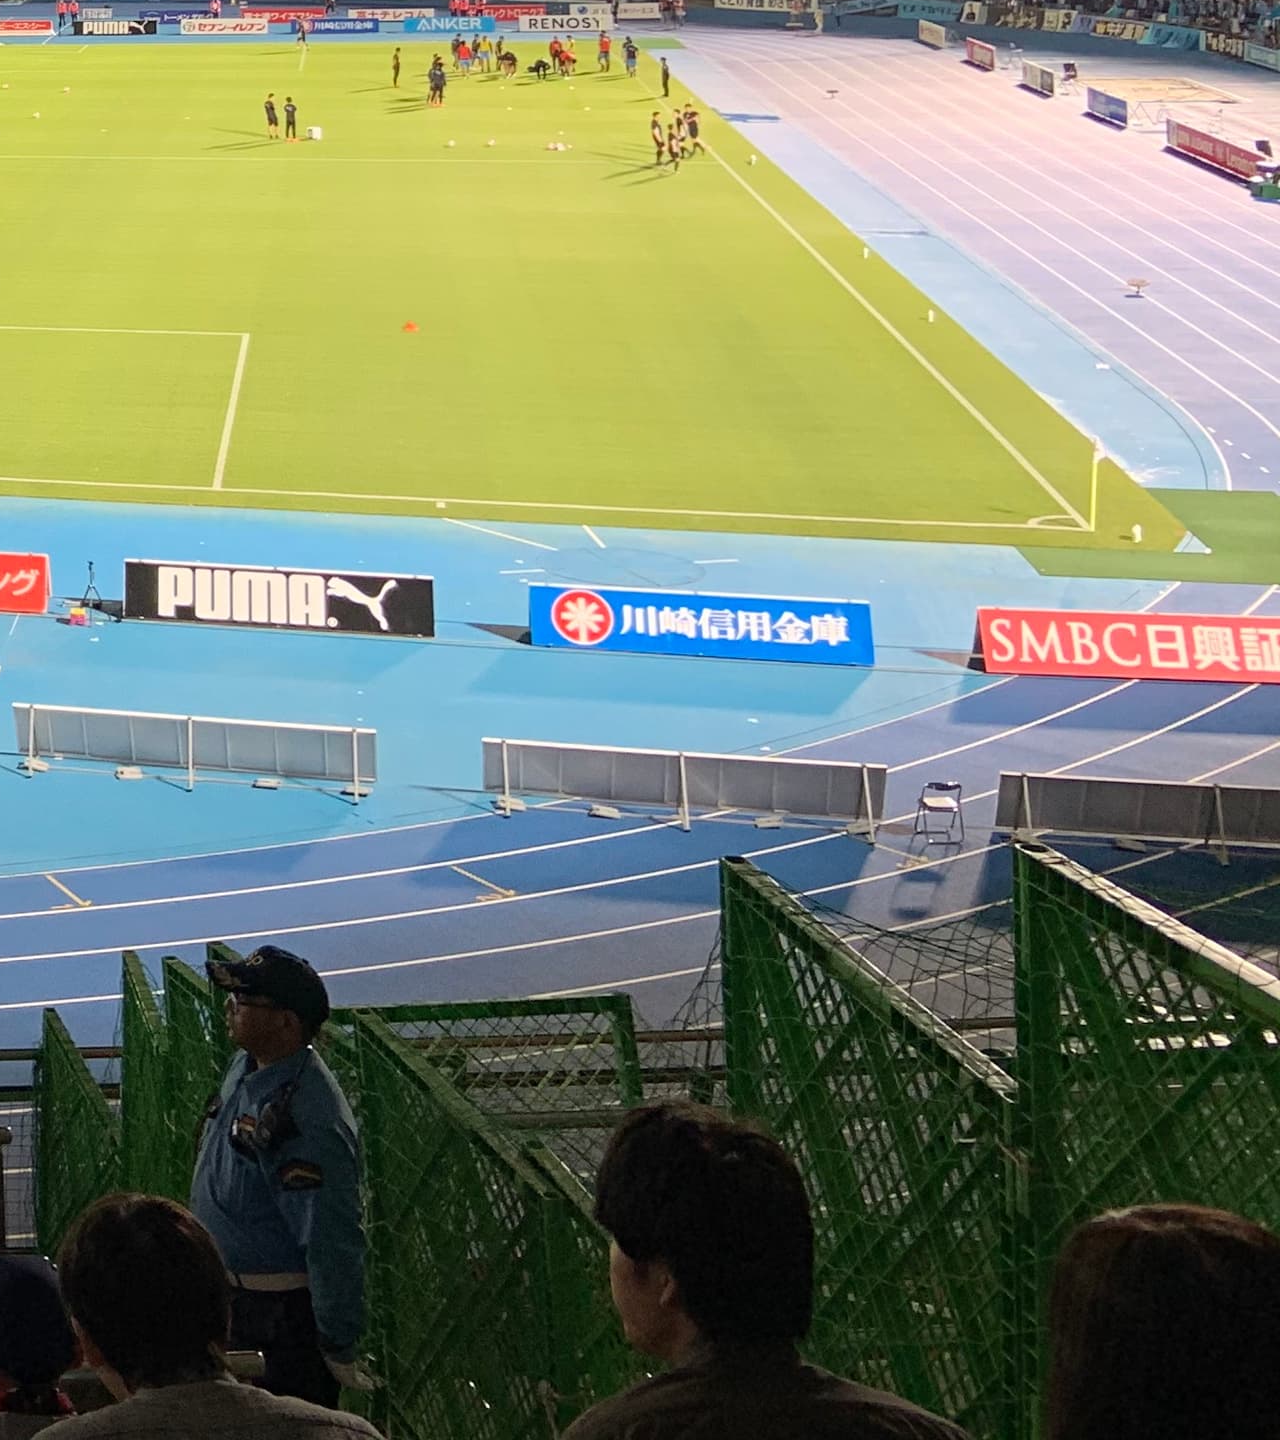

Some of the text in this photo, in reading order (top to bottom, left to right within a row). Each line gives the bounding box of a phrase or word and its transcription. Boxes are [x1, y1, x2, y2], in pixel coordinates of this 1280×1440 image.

[82, 21, 129, 35] PUMA
[416, 17, 483, 30] ANKER
[528, 16, 601, 30] RENOSY
[157, 565, 328, 628] PUMA
[620, 603, 852, 647] 川崎信用金庫
